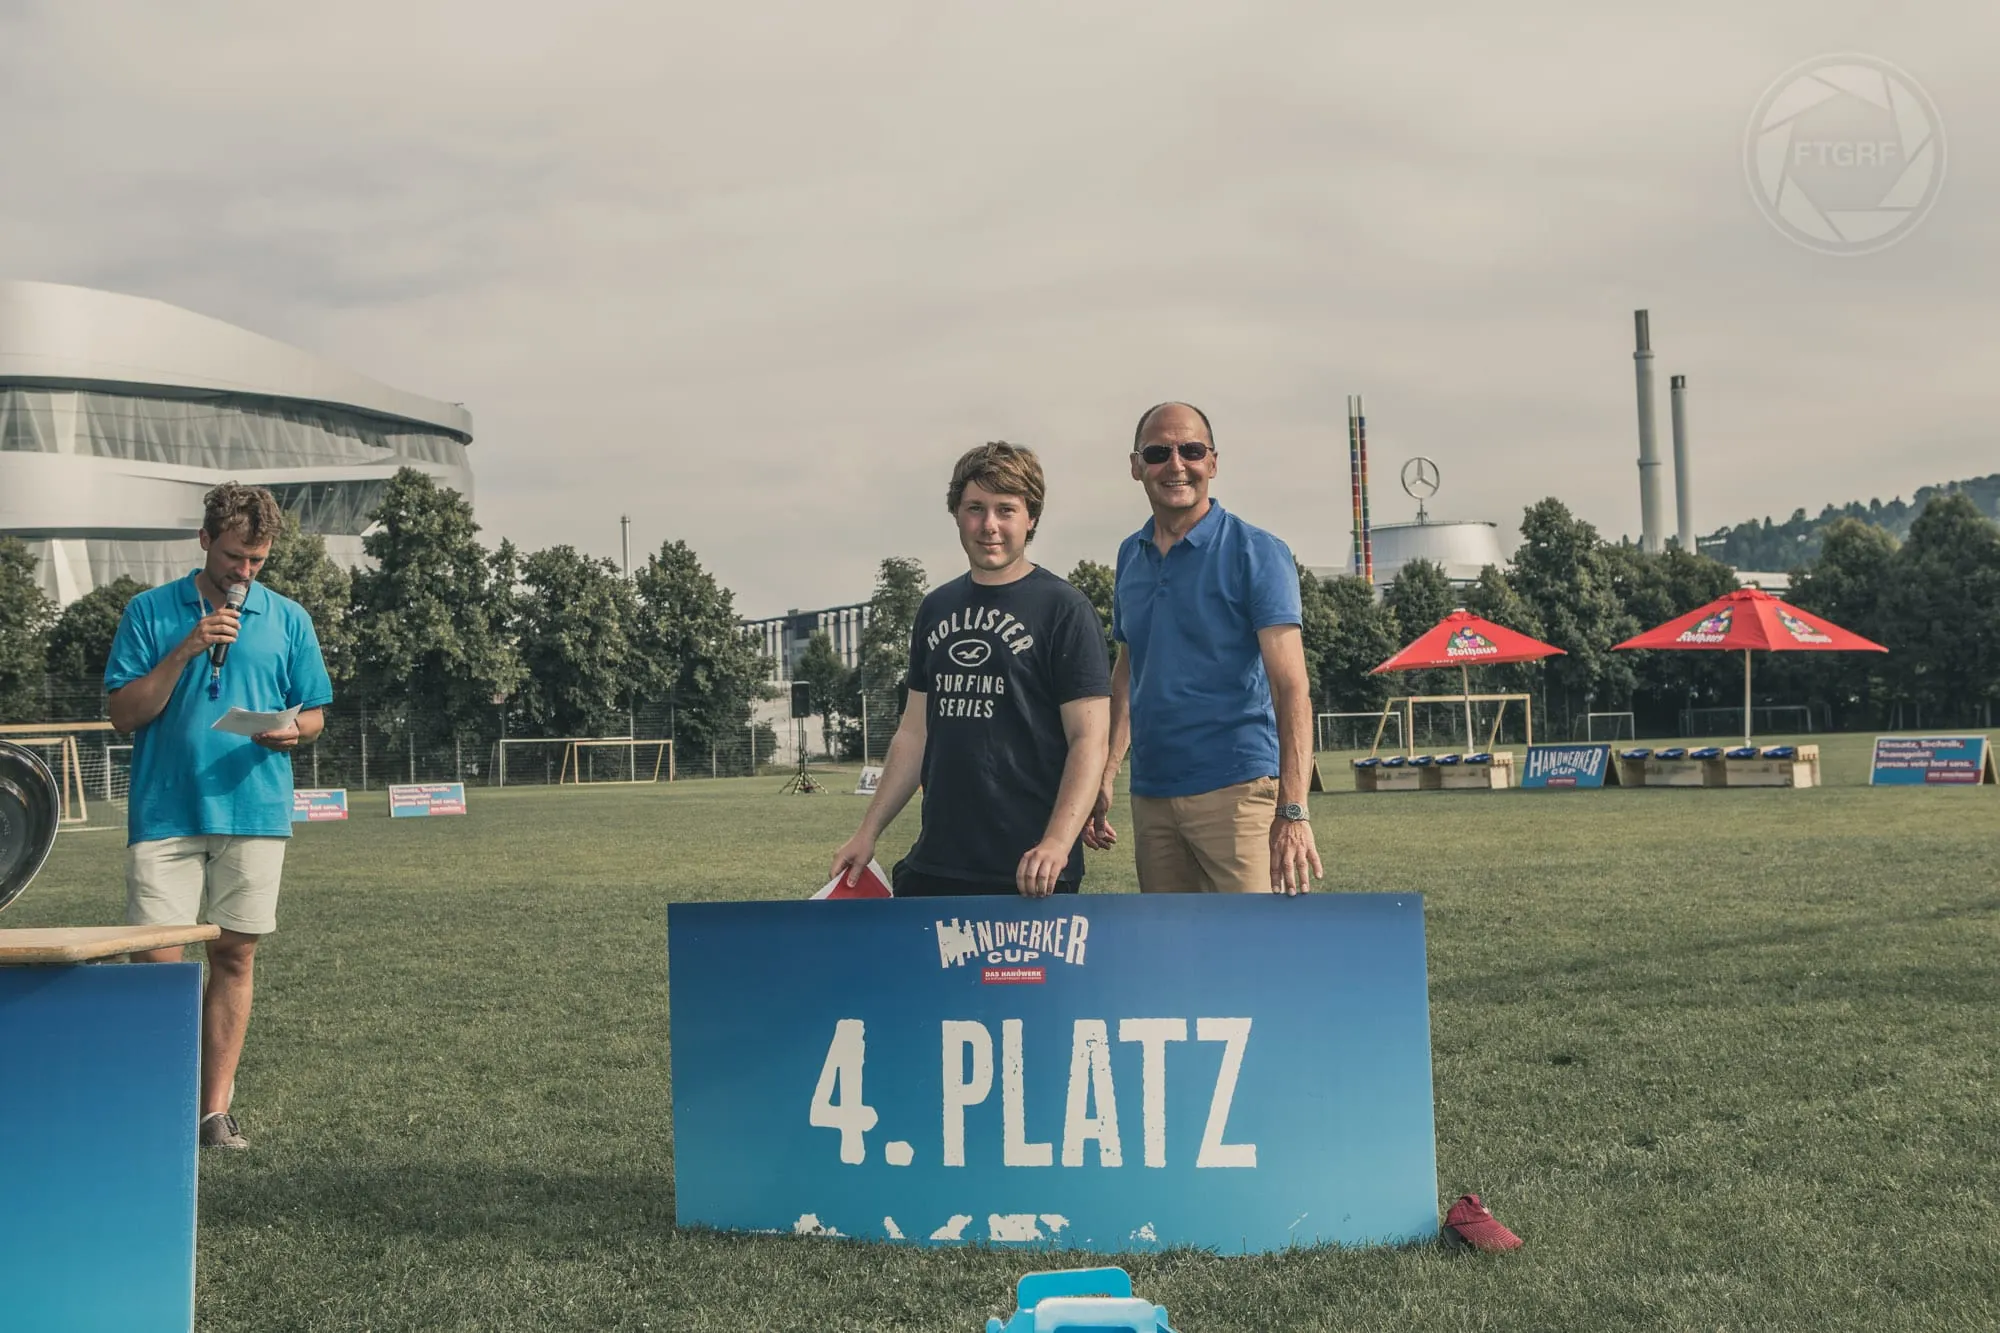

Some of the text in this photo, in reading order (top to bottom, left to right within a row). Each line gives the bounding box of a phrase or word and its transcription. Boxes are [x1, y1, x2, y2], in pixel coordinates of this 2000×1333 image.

[927, 606, 1034, 655] HOLLISTER
[1446, 646, 1498, 657] Rothaus
[935, 673, 1005, 695] SURFING
[939, 698, 995, 719] SERIES
[1529, 748, 1603, 778] HANDWERKER
[1551, 767, 1576, 776] CUP
[988, 949, 1040, 964] CUP
[809, 1017, 1257, 1168] 4. PLATZ
